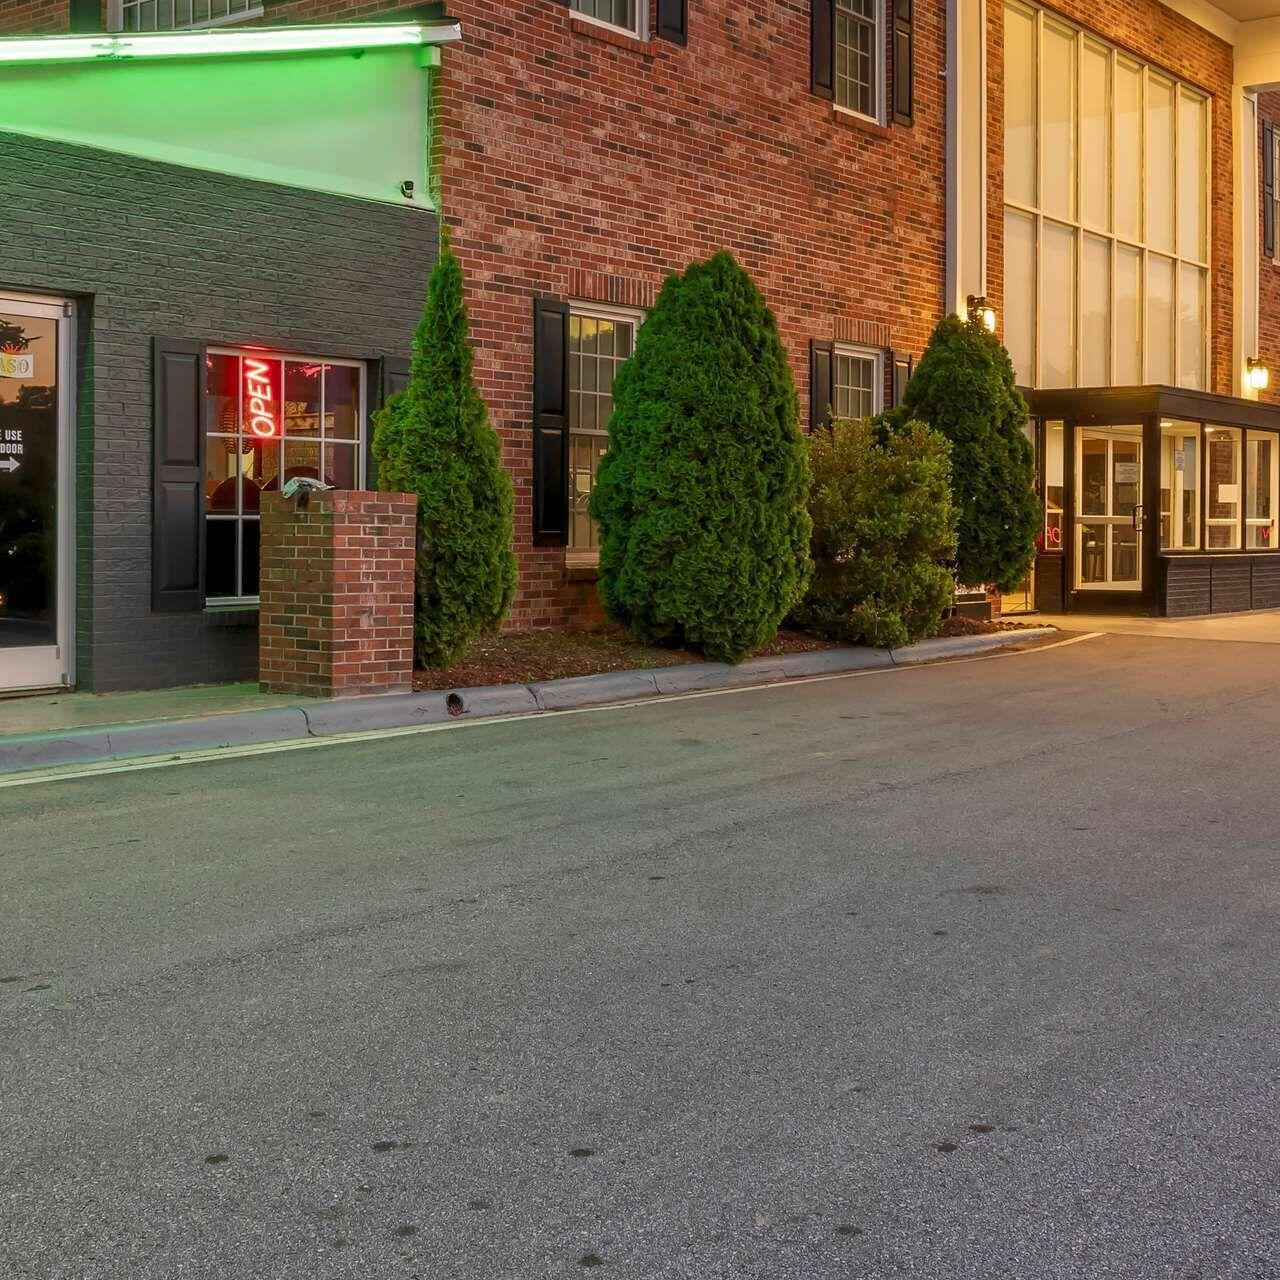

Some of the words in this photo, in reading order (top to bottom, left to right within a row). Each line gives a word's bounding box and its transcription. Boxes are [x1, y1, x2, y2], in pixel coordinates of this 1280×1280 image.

[244, 359, 276, 437] OPEN
[5, 430, 23, 441] USE
[0, 443, 24, 455] DOOR
